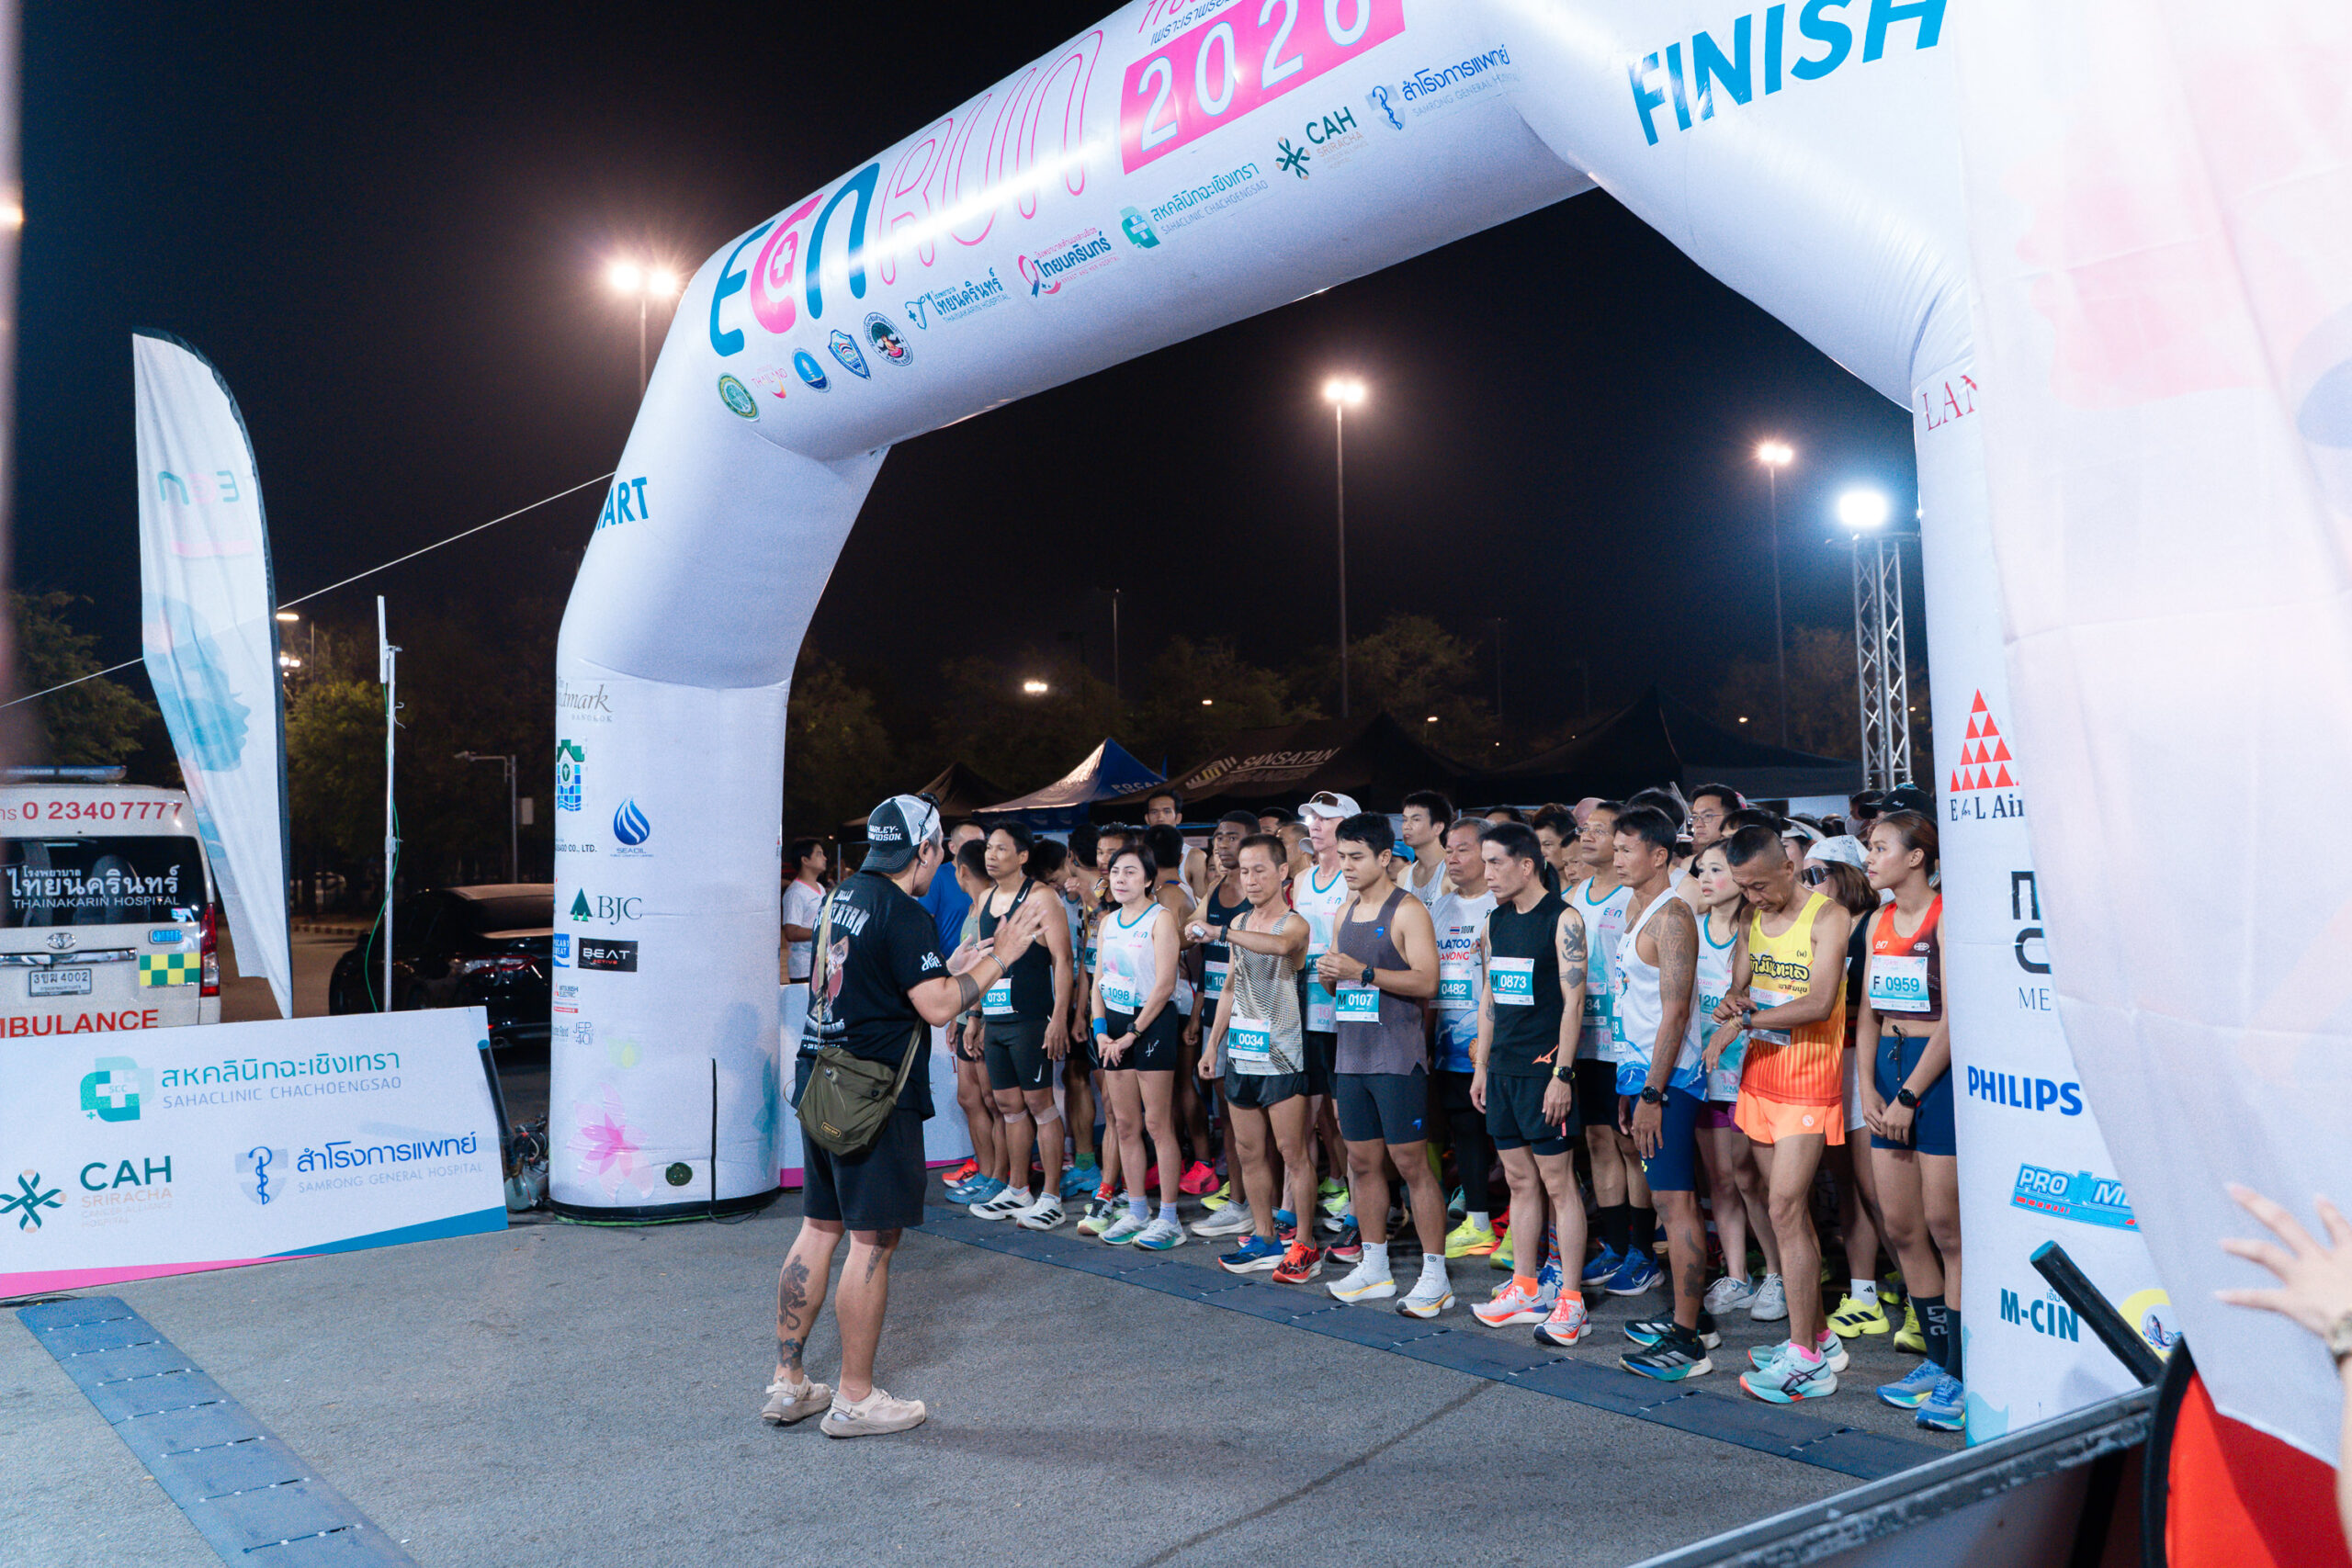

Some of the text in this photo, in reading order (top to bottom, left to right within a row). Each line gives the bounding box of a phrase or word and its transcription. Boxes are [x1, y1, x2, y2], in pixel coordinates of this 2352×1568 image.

[1626, 0, 1947, 146] FINISH
[1306, 107, 1357, 144] CAH
[1317, 131, 1363, 157] SRIRACHA
[1161, 211, 1204, 234] SAHACLINIC
[1205, 180, 1268, 215] CHACHOENGSAO
[1237, 747, 1341, 772] SANSATAN
[1974, 796, 1985, 819] L
[6, 864, 180, 897] ไทยนครินทร์
[24, 864, 81, 877] โรงพยาบาล
[13, 895, 180, 909] THAINAKARIN HOSPITAL
[597, 896, 642, 925] BJC
[582, 947, 630, 960] BEAT
[1441, 952, 1470, 961] AYONG
[61, 972, 87, 982] 4002
[1491, 975, 1526, 988] M 0873
[1873, 976, 1920, 992] F 0959
[988, 992, 1006, 1003] 0733
[1108, 987, 1130, 1001] 1098
[1338, 994, 1374, 1006] M 0107
[1442, 984, 1466, 995] 0482
[1229, 1033, 1264, 1046] M 0034
[162, 1052, 401, 1088] สหคลินิกฉะเชิงเทรา
[108, 1084, 128, 1093] SCC
[164, 1077, 402, 1109] SAHACLINIC CHACHOENGSAO
[1968, 1065, 2083, 1117] PHILIPS
[297, 1132, 477, 1173] สำโรงการแพทย์
[81, 1156, 172, 1191] CAH
[298, 1163, 482, 1194] SAMRONG GENERAL HOSPITAL
[2018, 1167, 2069, 1195] PRO
[82, 1187, 173, 1208] SRIRACHA
[2001, 1288, 2079, 1343] M-CIN
